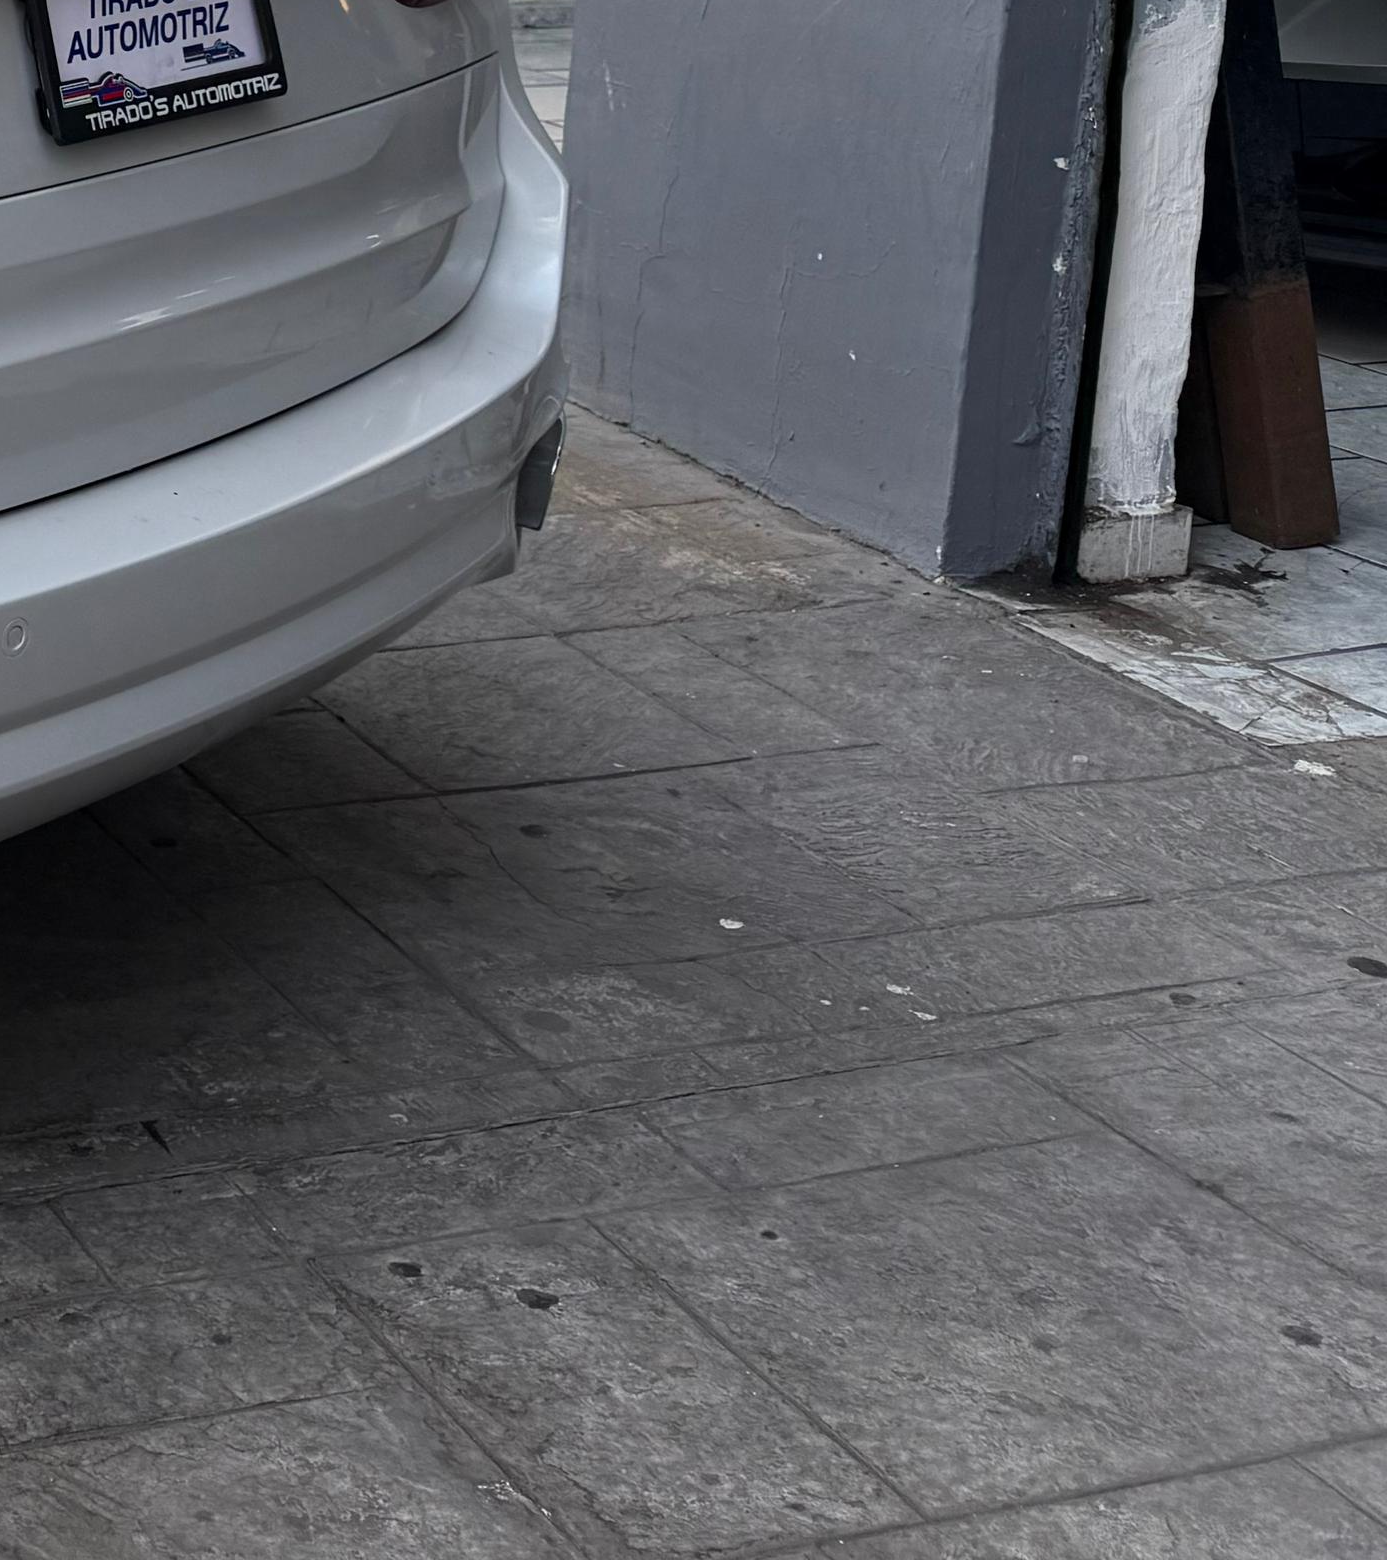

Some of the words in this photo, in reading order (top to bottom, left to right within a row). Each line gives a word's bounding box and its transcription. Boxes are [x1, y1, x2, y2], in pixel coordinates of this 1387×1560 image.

[66, 0, 230, 64] AUTOMOTRIZ
[84, 95, 169, 132] TIRADO'S
[172, 72, 282, 113] AUTOMOTRIZ
